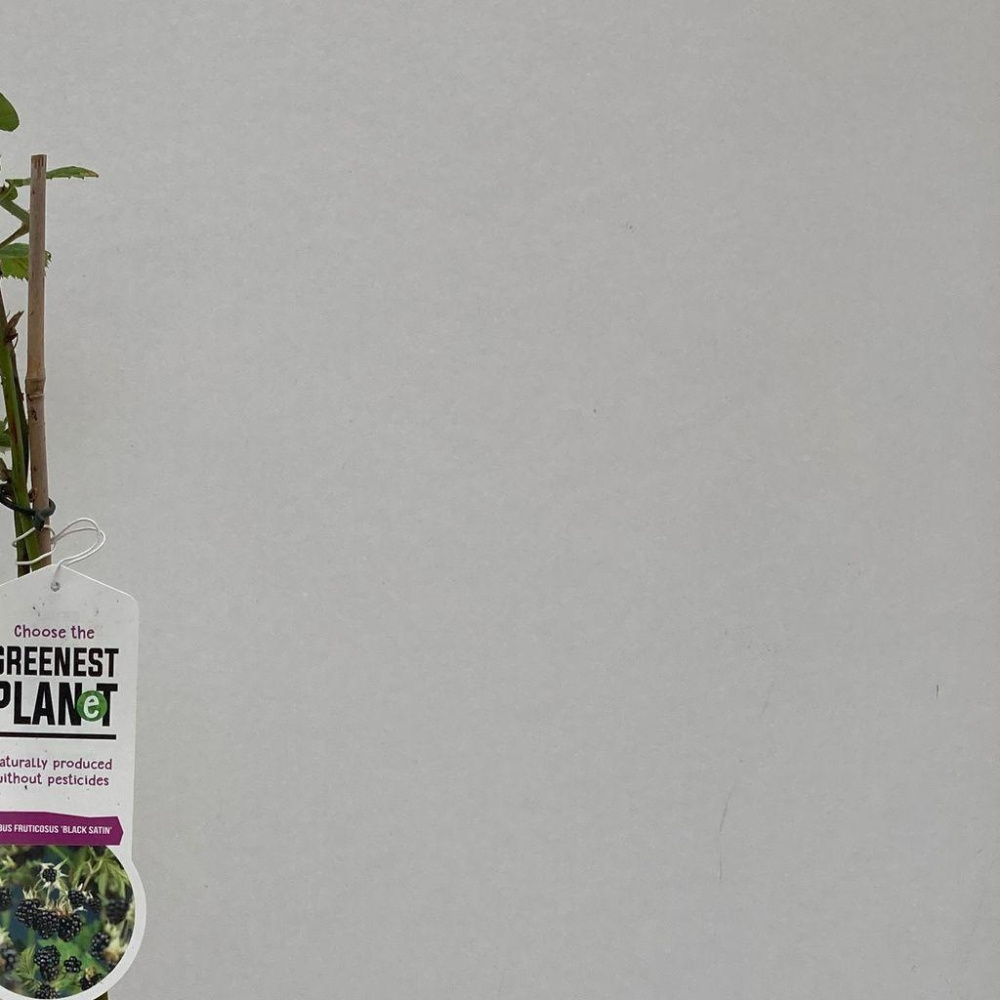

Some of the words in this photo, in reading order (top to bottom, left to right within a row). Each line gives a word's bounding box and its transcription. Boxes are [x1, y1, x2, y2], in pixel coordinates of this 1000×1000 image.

[14, 624, 66, 640] Choose
[70, 625, 95, 639] the
[53, 757, 113, 771] produced
[47, 773, 110, 787] pesticides
[13, 824, 59, 833] FRUTICOSUS
